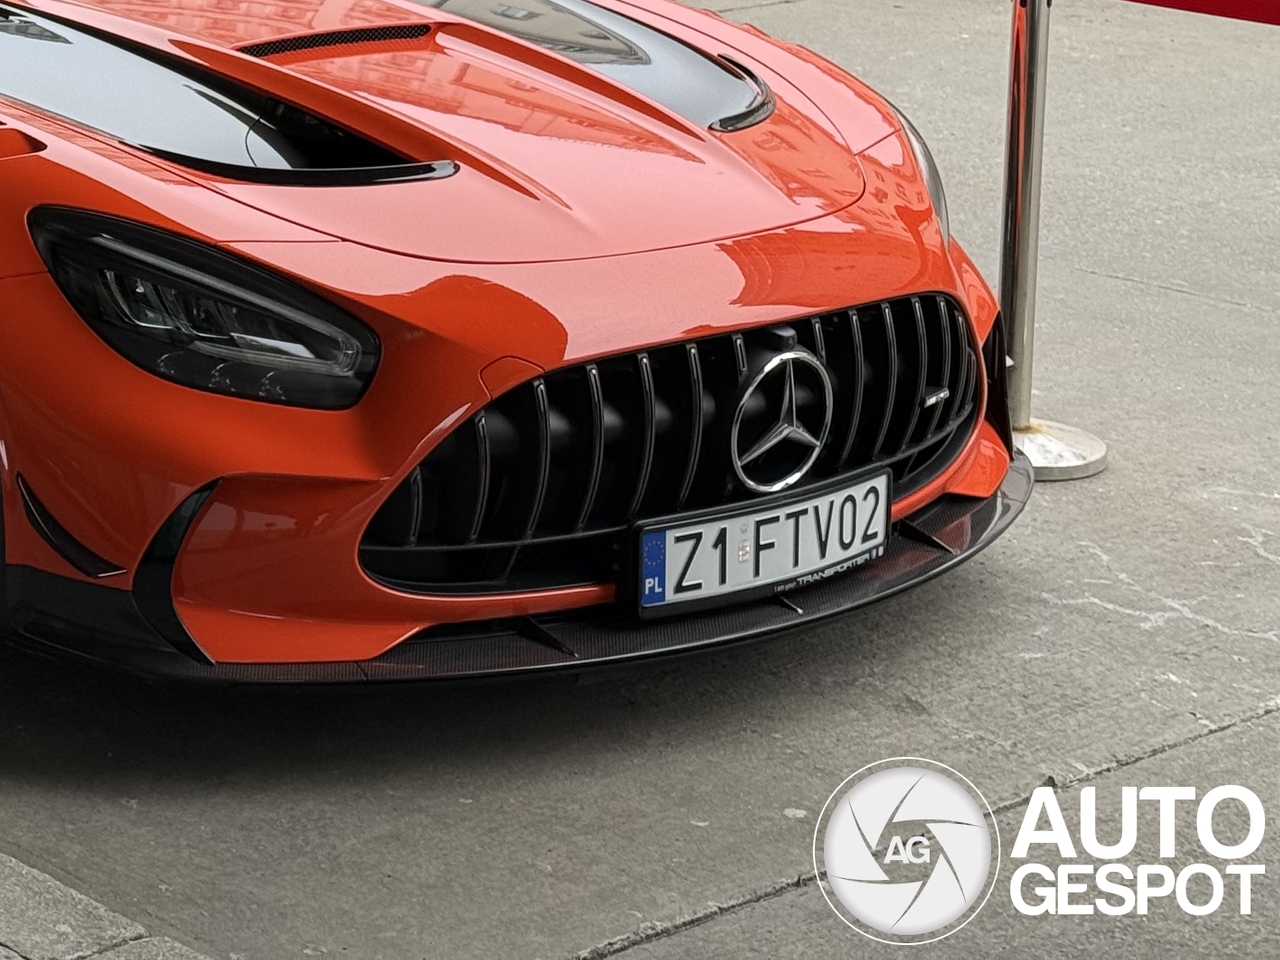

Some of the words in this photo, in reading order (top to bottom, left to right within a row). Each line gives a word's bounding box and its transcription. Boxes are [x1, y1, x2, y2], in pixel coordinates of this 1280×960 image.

[673, 526, 729, 595] Z1
[796, 552, 871, 586] TRANSPORTER
[644, 577, 663, 595] PL
